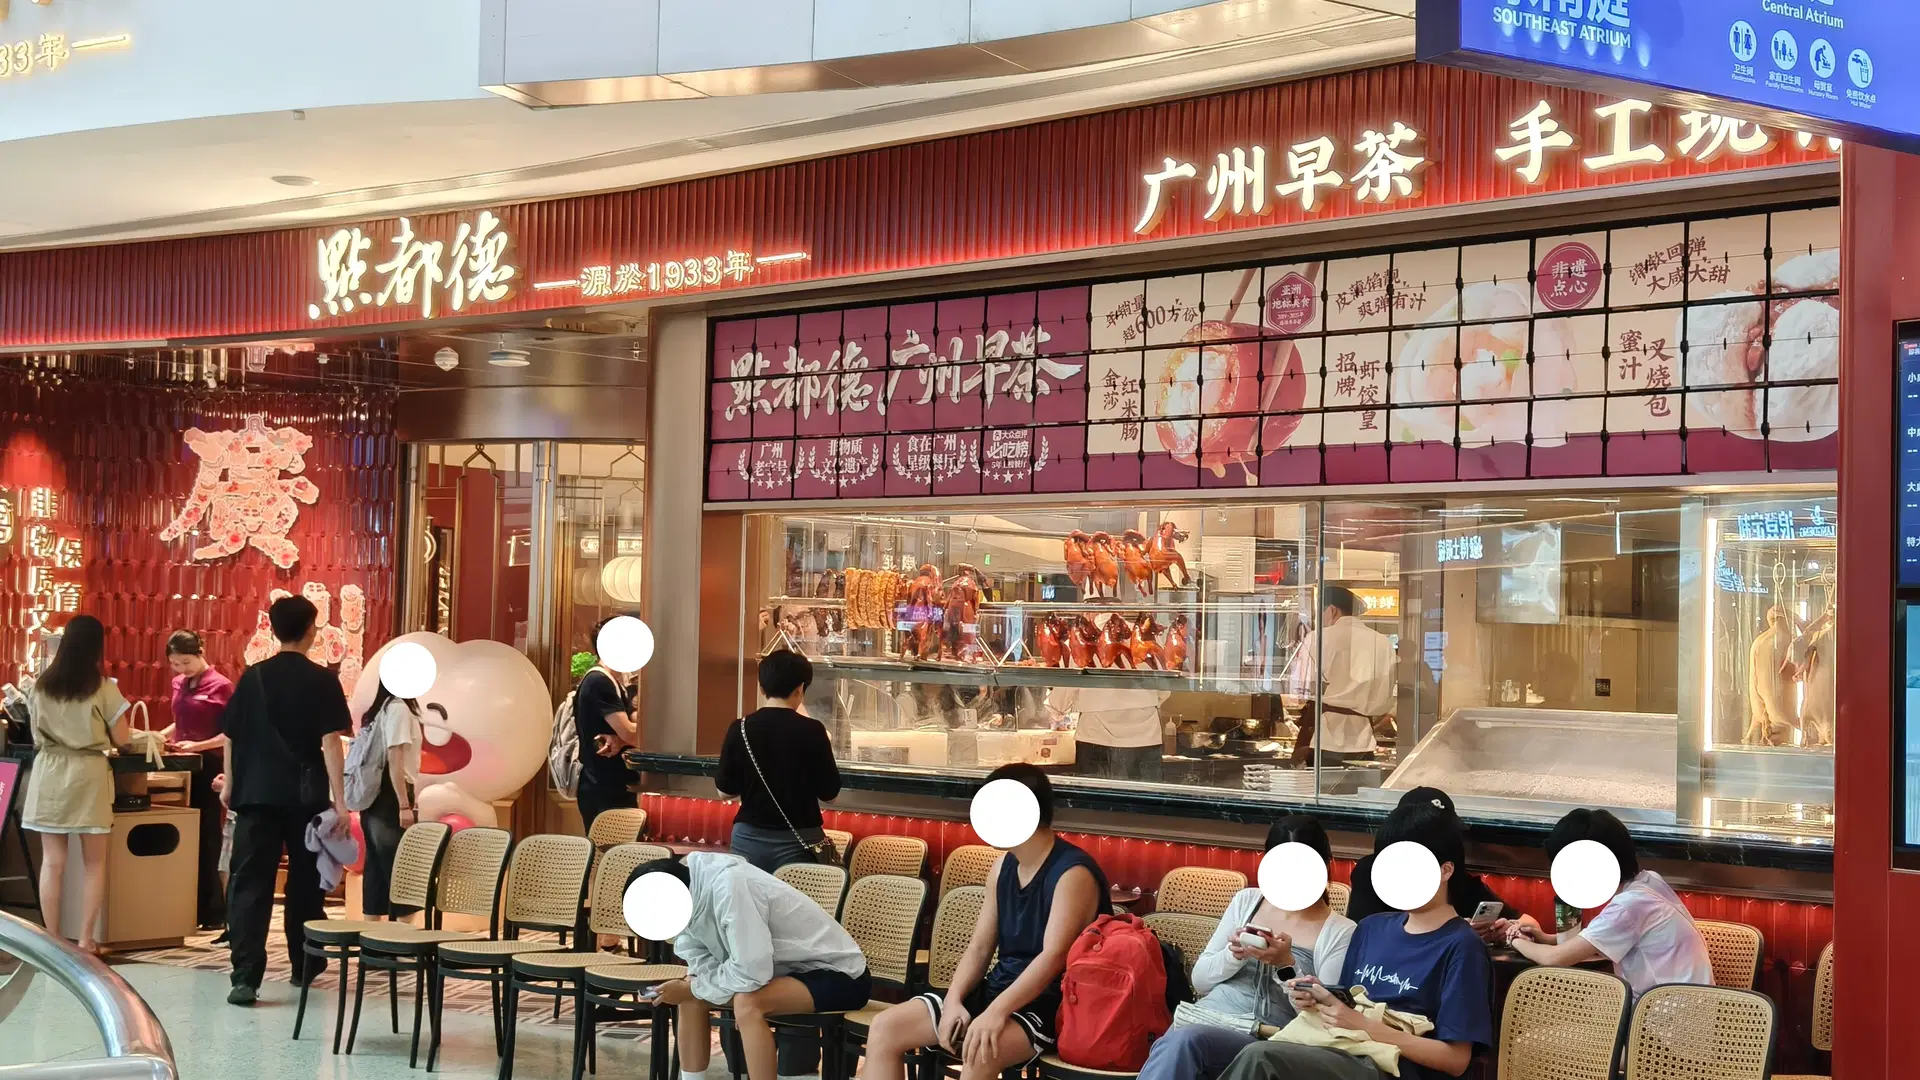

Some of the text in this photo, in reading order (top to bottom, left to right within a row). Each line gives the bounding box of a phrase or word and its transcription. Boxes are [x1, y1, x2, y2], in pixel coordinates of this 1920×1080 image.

[1493, 7, 1577, 37] SOUTHEAST
[1579, 24, 1631, 48] ATRIUM
[1762, 0, 1844, 29] Central Atrium
[1734, 64, 1754, 76] 卫生间
[1134, 121, 1425, 233] 广州早茶
[308, 211, 756, 319] 點都德 源於1933年
[1551, 259, 1588, 280] 非遗
[1629, 236, 1707, 285] 绵软回弹
[1551, 279, 1589, 299] 点心
[1647, 264, 1731, 297] 大咸大甜
[1357, 292, 1427, 323] 爽弹有汁
[876, 324, 1084, 417] 广州早茶
[1618, 329, 1643, 381] 蜜汁
[1101, 367, 1121, 411] 金莎
[1333, 351, 1358, 398] 招牌
[1644, 338, 1674, 417] 叉烧包
[1119, 376, 1139, 441] 红米肠
[1357, 359, 1380, 430] 虾饺皇
[828, 438, 863, 456] 非物质
[907, 433, 956, 452] 食在广州
[986, 440, 1029, 459] 必吃榜
[1001, 430, 1028, 439] 大众点评
[760, 442, 783, 459] 广州
[821, 456, 869, 474] 文化遗产
[907, 452, 957, 471] 星级餐厅
[754, 459, 788, 477] 老字号
